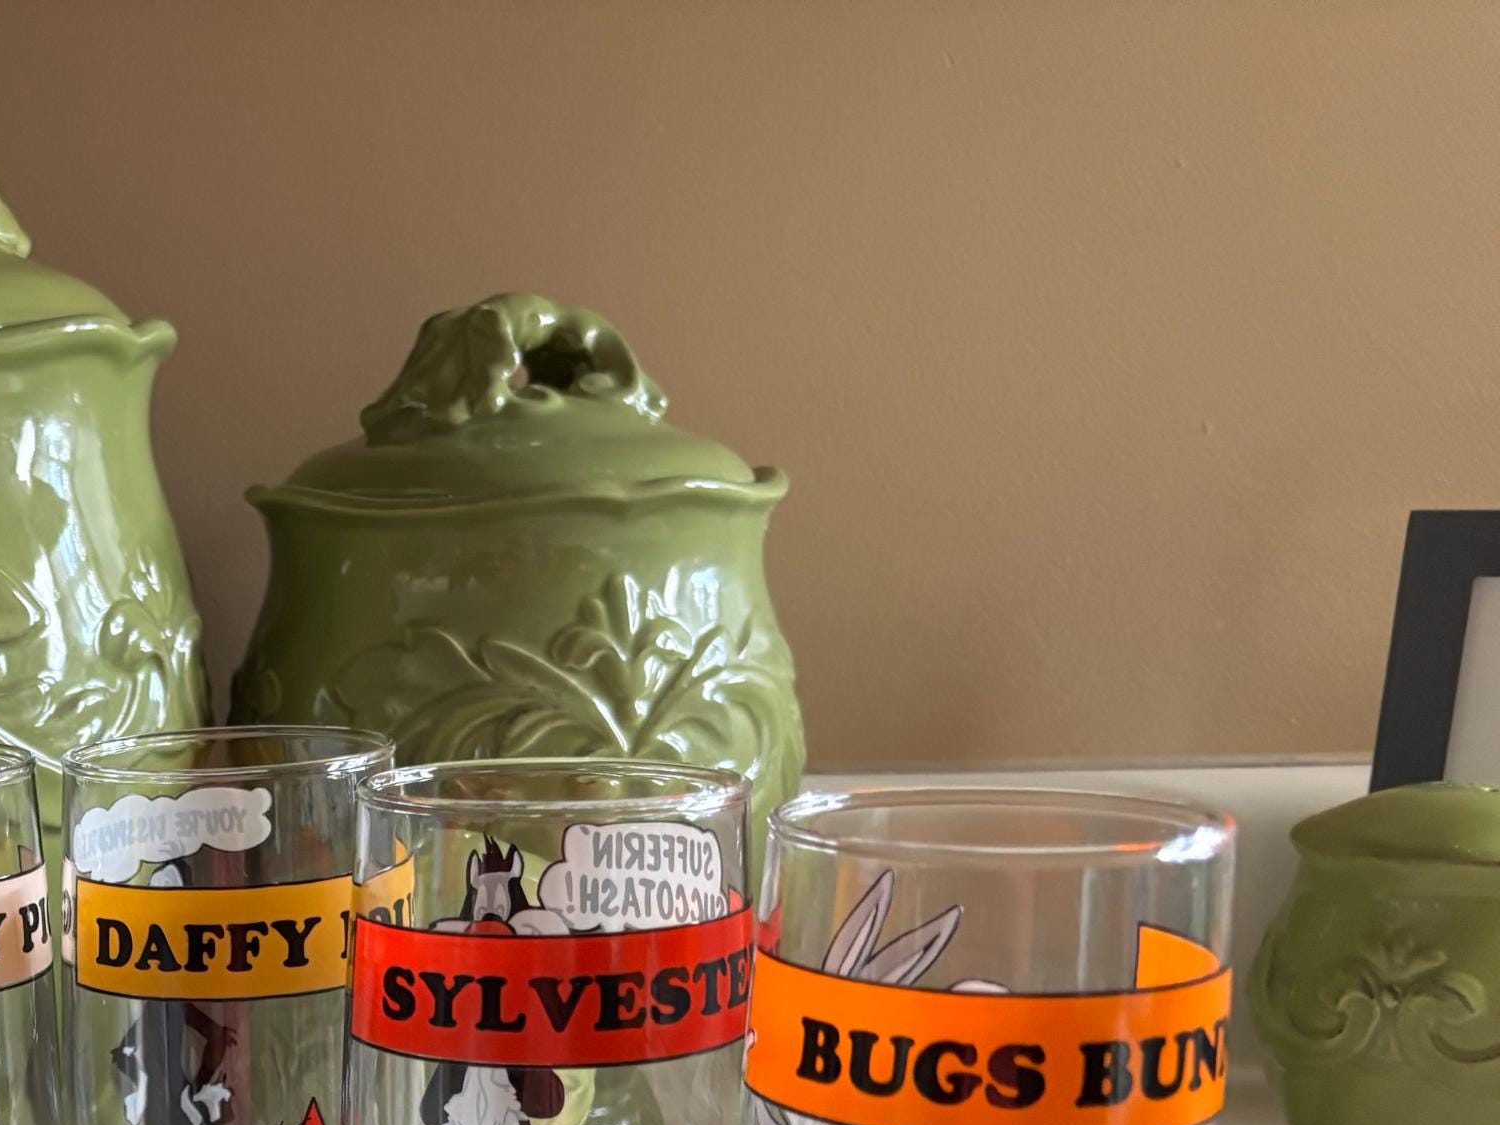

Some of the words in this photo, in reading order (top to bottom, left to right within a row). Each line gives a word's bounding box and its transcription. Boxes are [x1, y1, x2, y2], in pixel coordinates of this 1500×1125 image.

[19, 897, 51, 953] PI
[96, 917, 321, 973] DAFFY
[381, 942, 756, 1034] SYLVESTE
[796, 1016, 1046, 1109] BUGS
[1074, 1018, 1227, 1108] BUN
